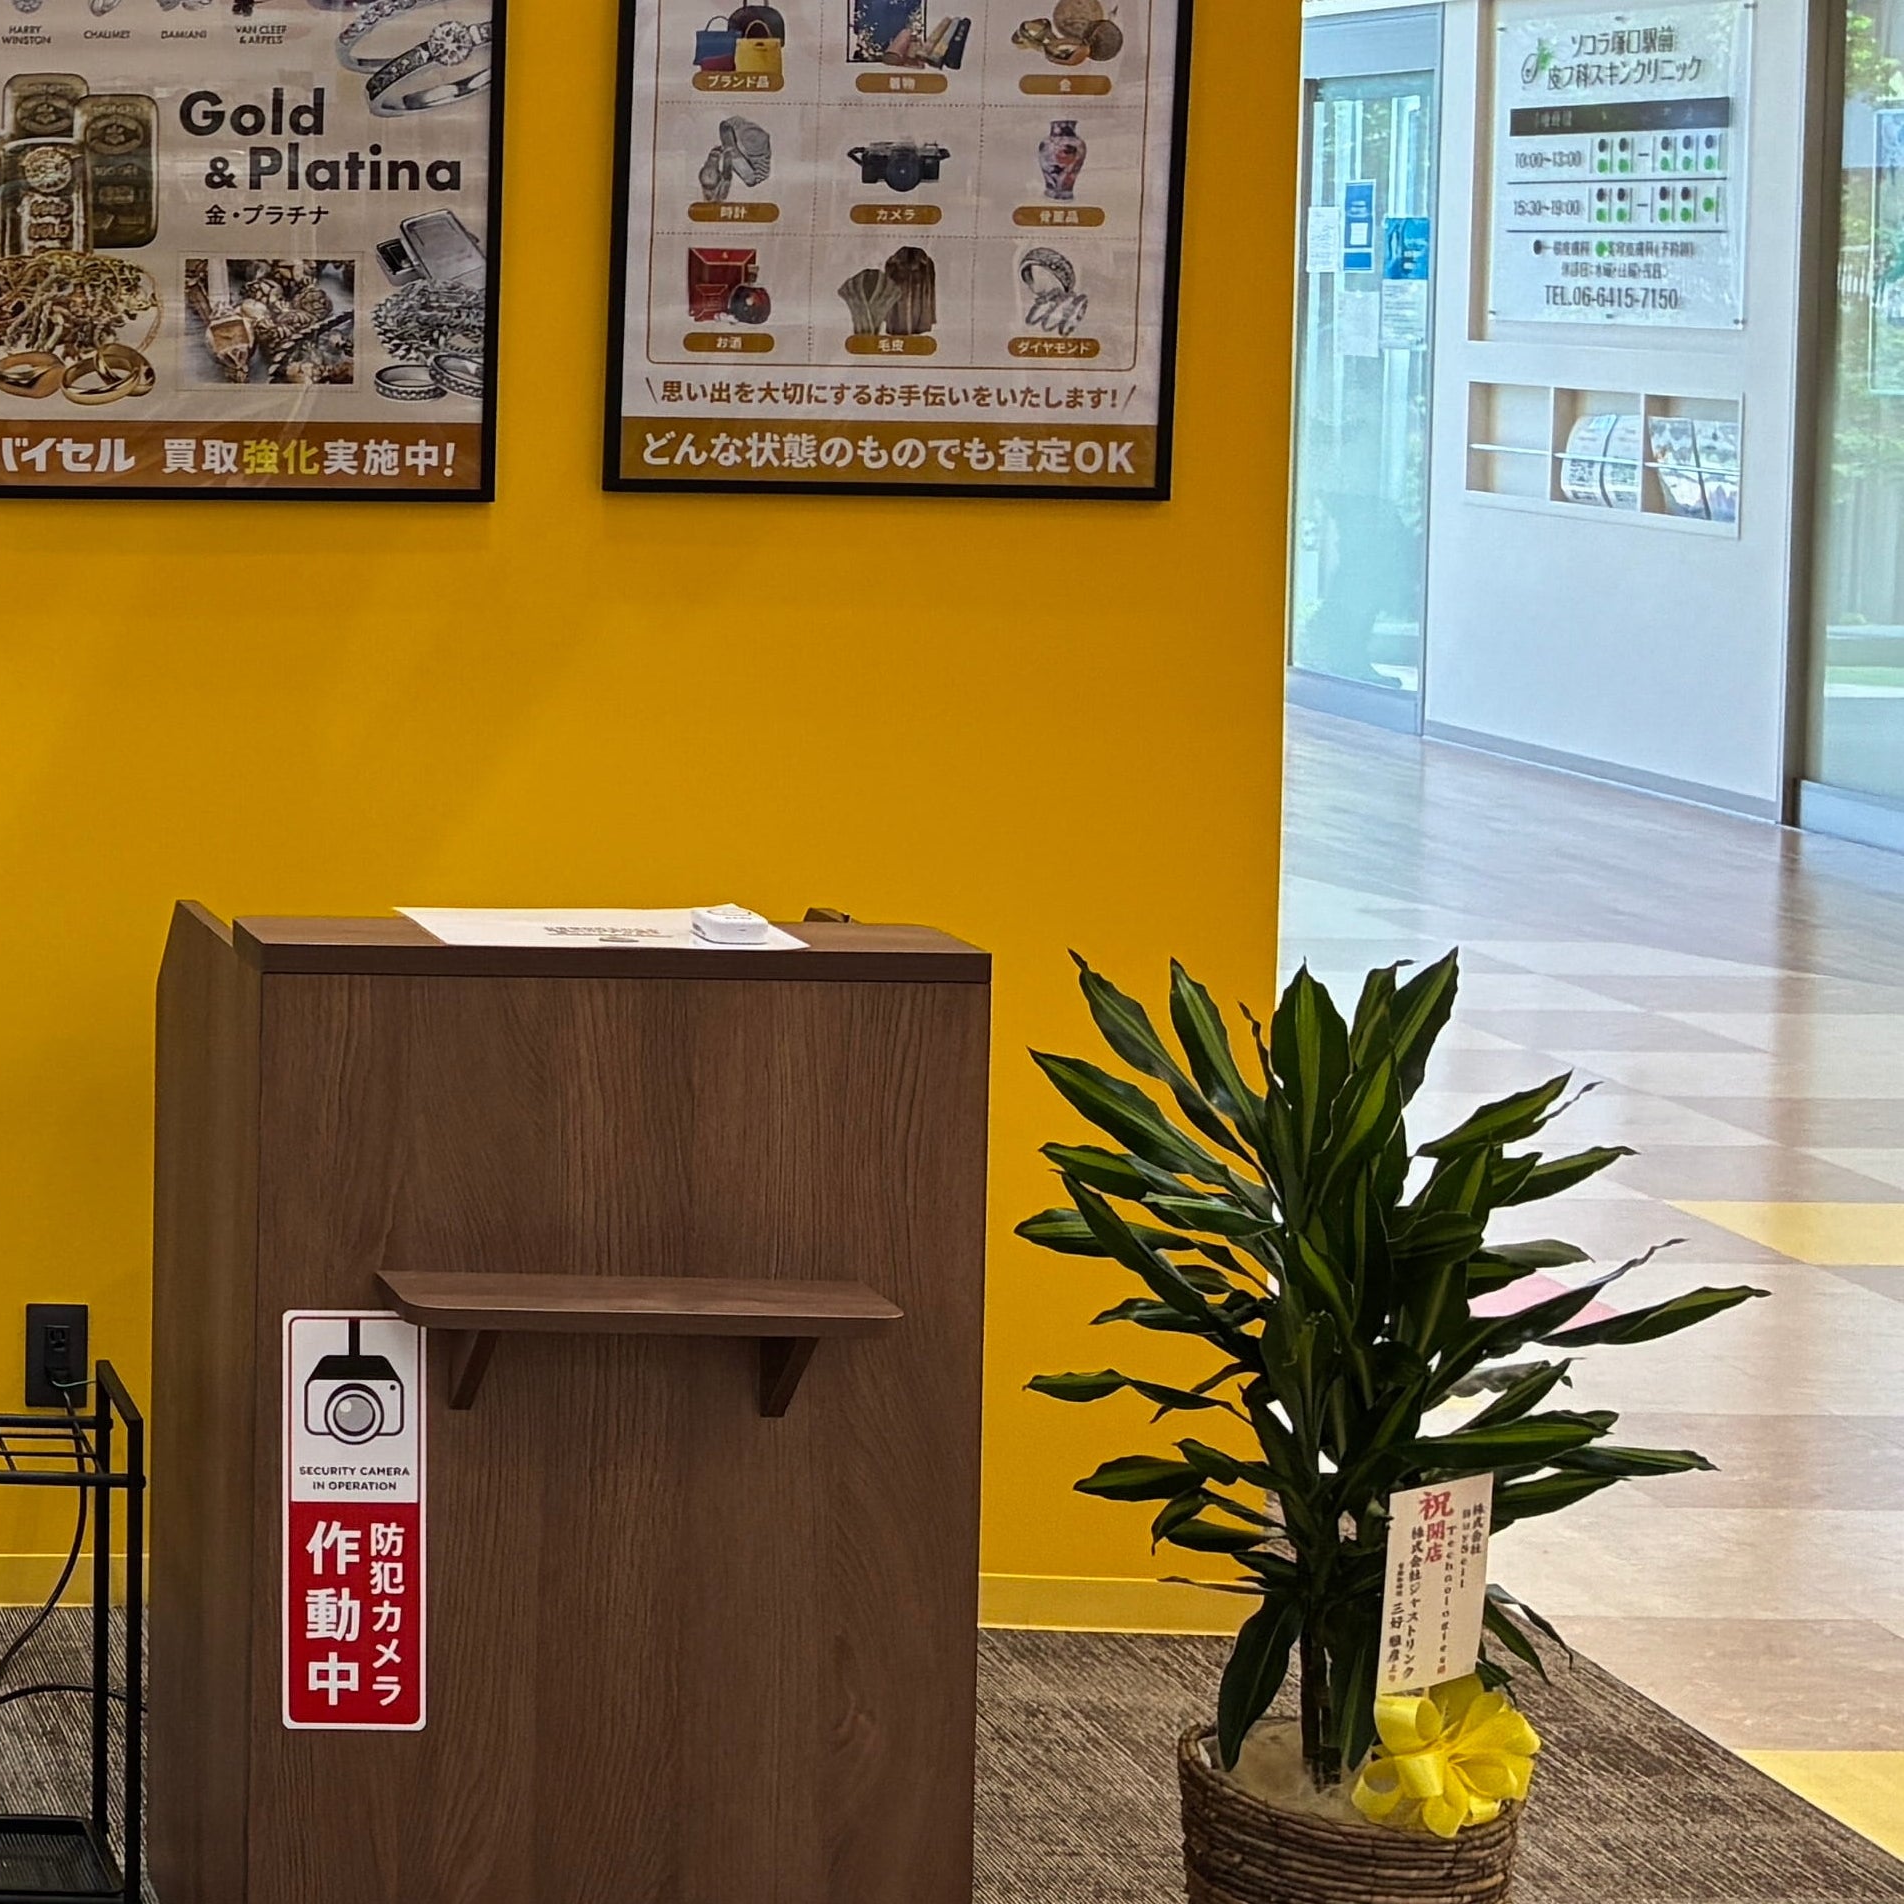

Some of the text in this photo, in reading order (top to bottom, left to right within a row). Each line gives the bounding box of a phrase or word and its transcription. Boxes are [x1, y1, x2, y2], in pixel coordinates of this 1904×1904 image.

[1, 35, 52, 45] WINSTON
[707, 75, 771, 90] ブランド品
[1548, 56, 1703, 91] 皮フ科スキンクリニック
[179, 87, 325, 136] Gold
[204, 142, 461, 191] & Platina
[204, 204, 330, 225] 金・プラチナ
[876, 208, 918, 222] カメラ
[1017, 341, 1092, 355] ダイヤモンド
[163, 438, 455, 477] 買取強化実施中!
[641, 431, 1136, 474] どんな状態のものでも査定OK
[299, 1466, 410, 1477] SECURITY CAMERA
[313, 1481, 397, 1491] IN OPERATION
[305, 1520, 362, 1706] 作動中
[369, 1522, 405, 1707] 防犯カメラ
